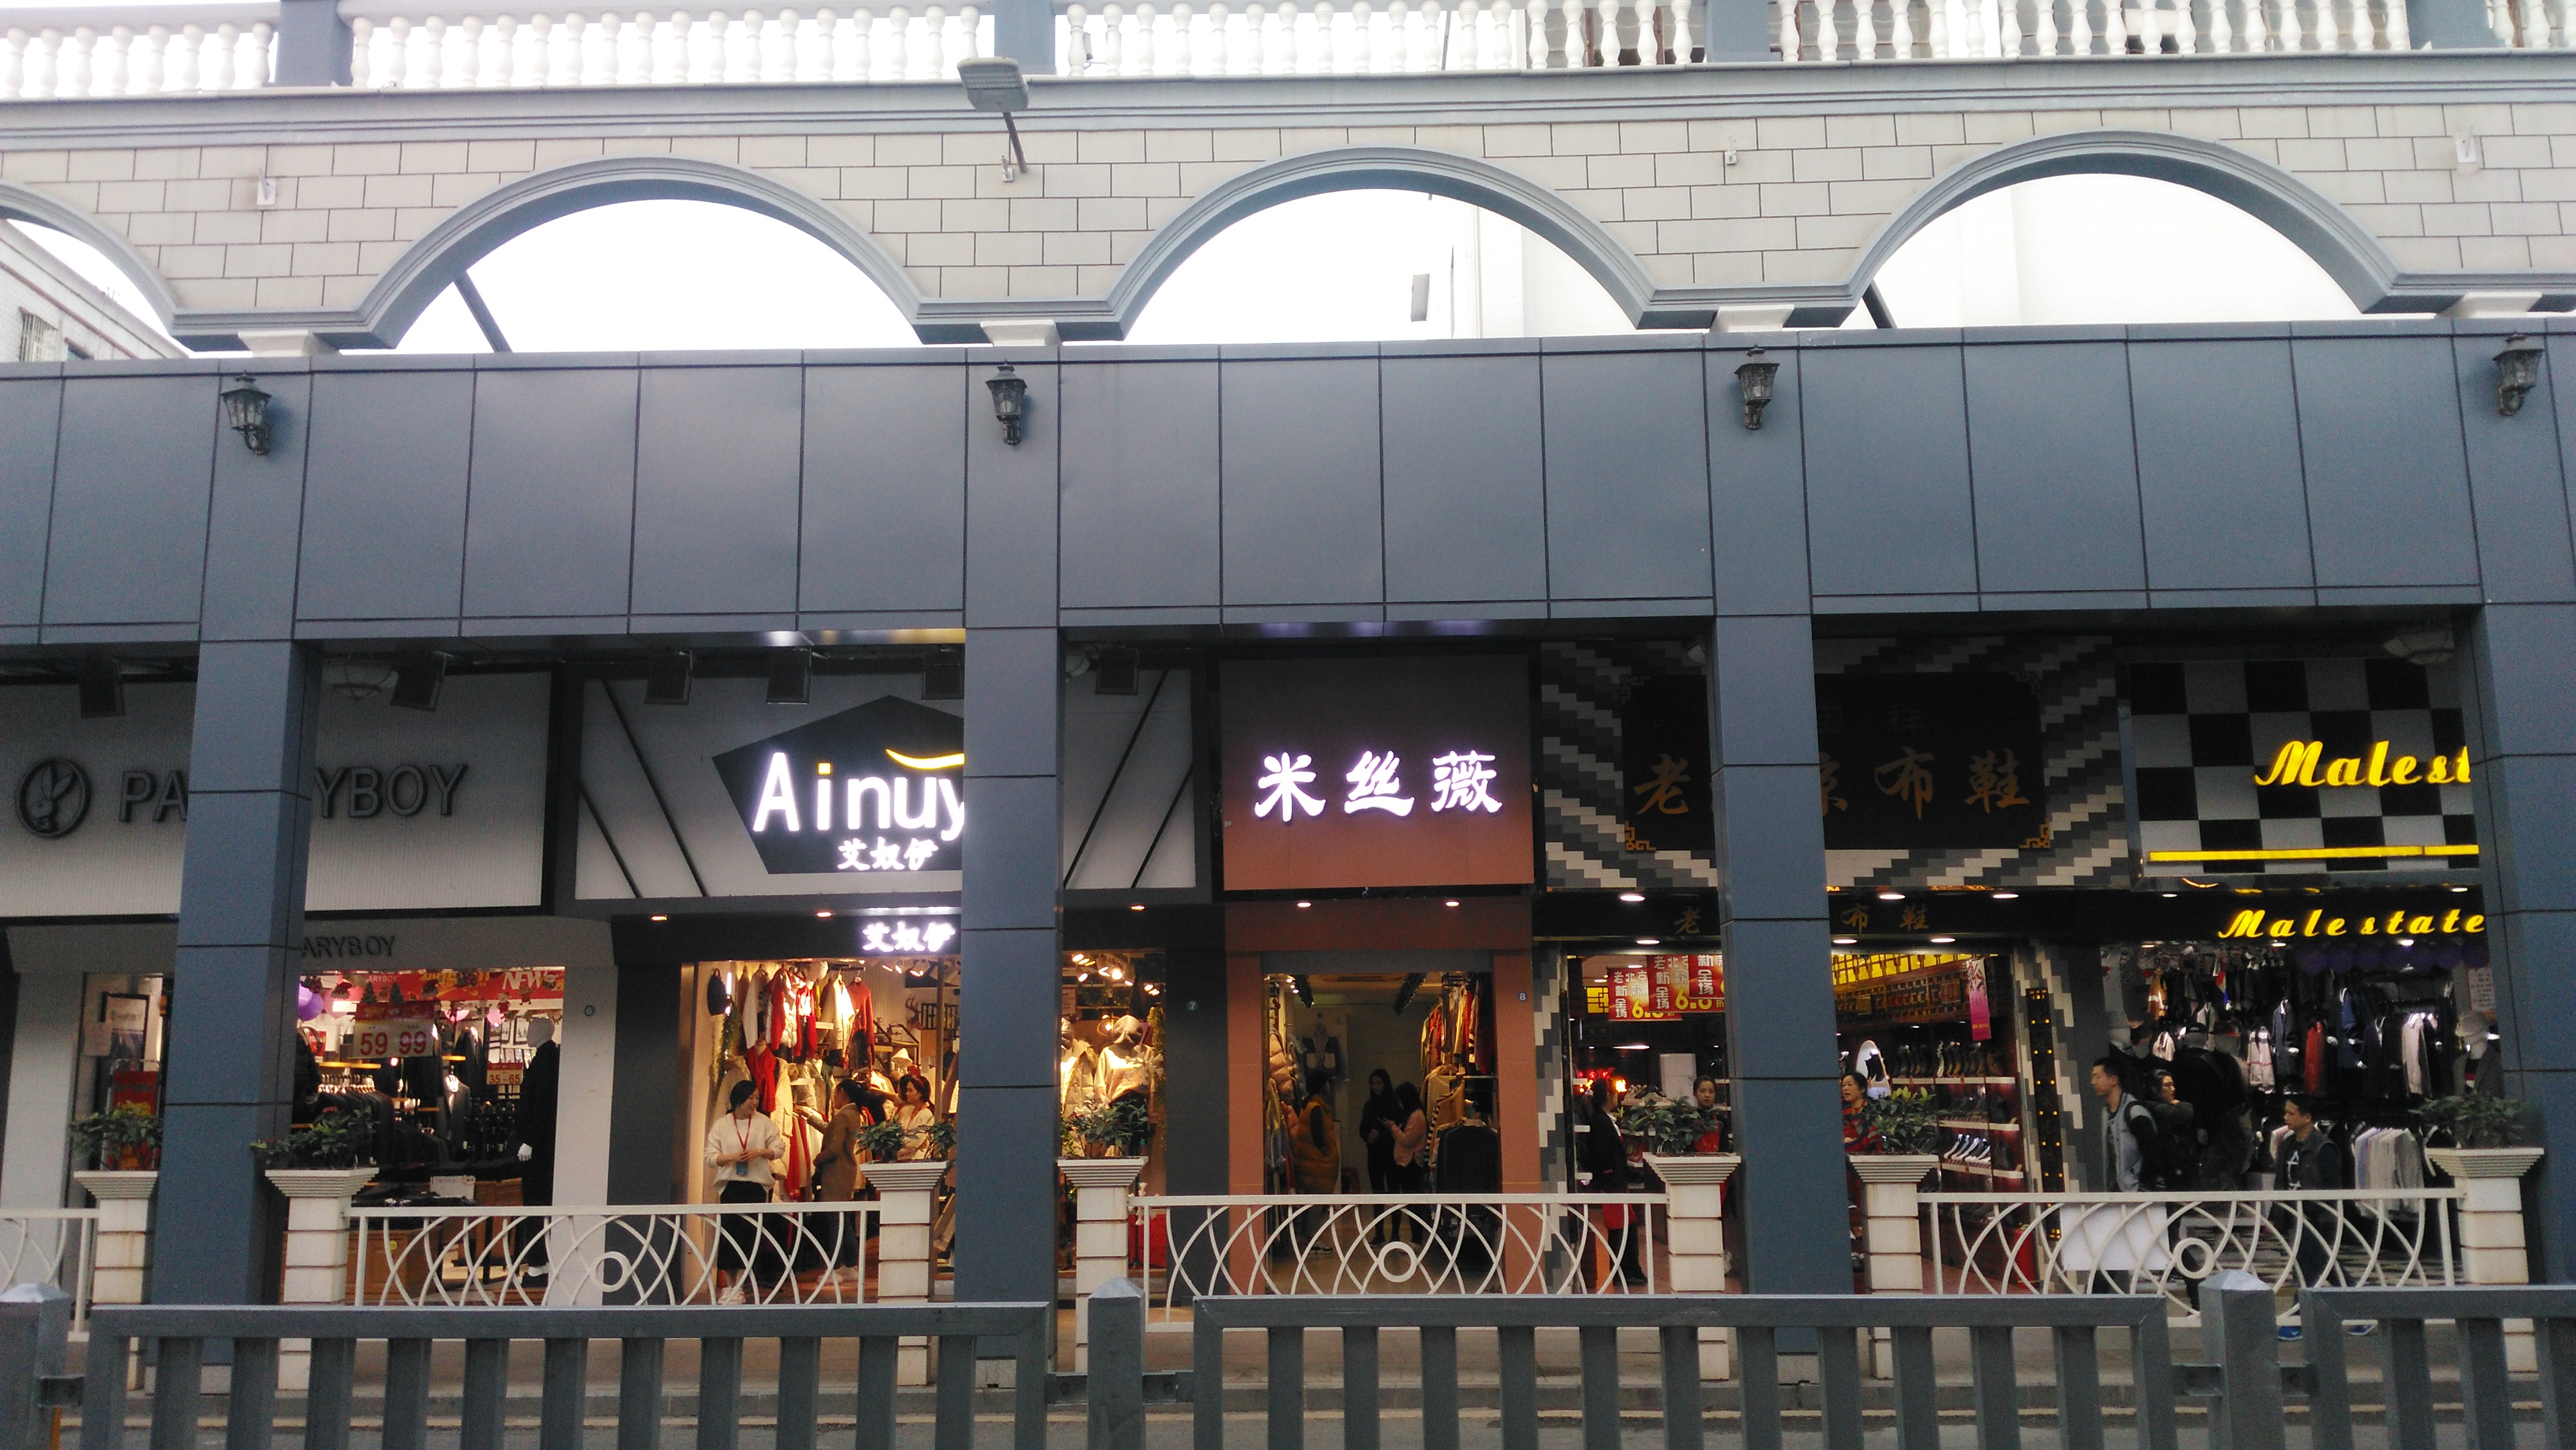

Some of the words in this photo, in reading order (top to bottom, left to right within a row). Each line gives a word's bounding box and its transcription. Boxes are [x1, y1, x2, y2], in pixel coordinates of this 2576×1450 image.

[1254, 750, 1502, 822] 米丝薇
[1519, 992, 1526, 1001] 8
[360, 1032, 388, 1056] 59
[399, 1031, 427, 1055] 99
[489, 1075, 500, 1083] 35
[509, 1074, 520, 1083] 65
